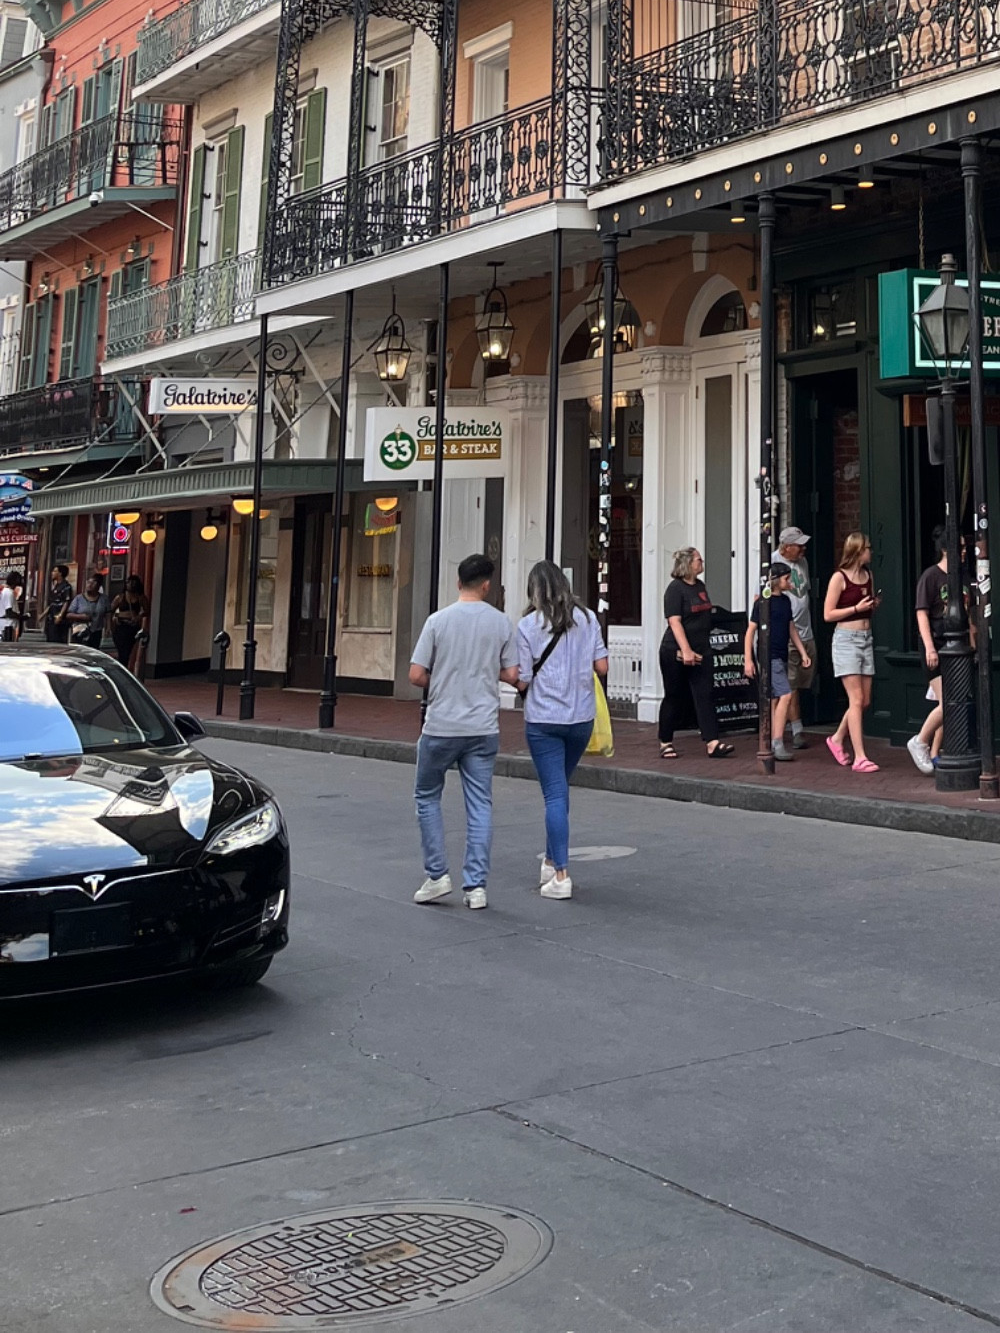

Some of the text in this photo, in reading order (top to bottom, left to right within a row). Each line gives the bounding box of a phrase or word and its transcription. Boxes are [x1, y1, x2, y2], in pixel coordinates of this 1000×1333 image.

[164, 384, 258, 407] Galatoire's
[384, 440, 412, 463] 33
[450, 444, 459, 454] &
[461, 443, 498, 454] STEAK
